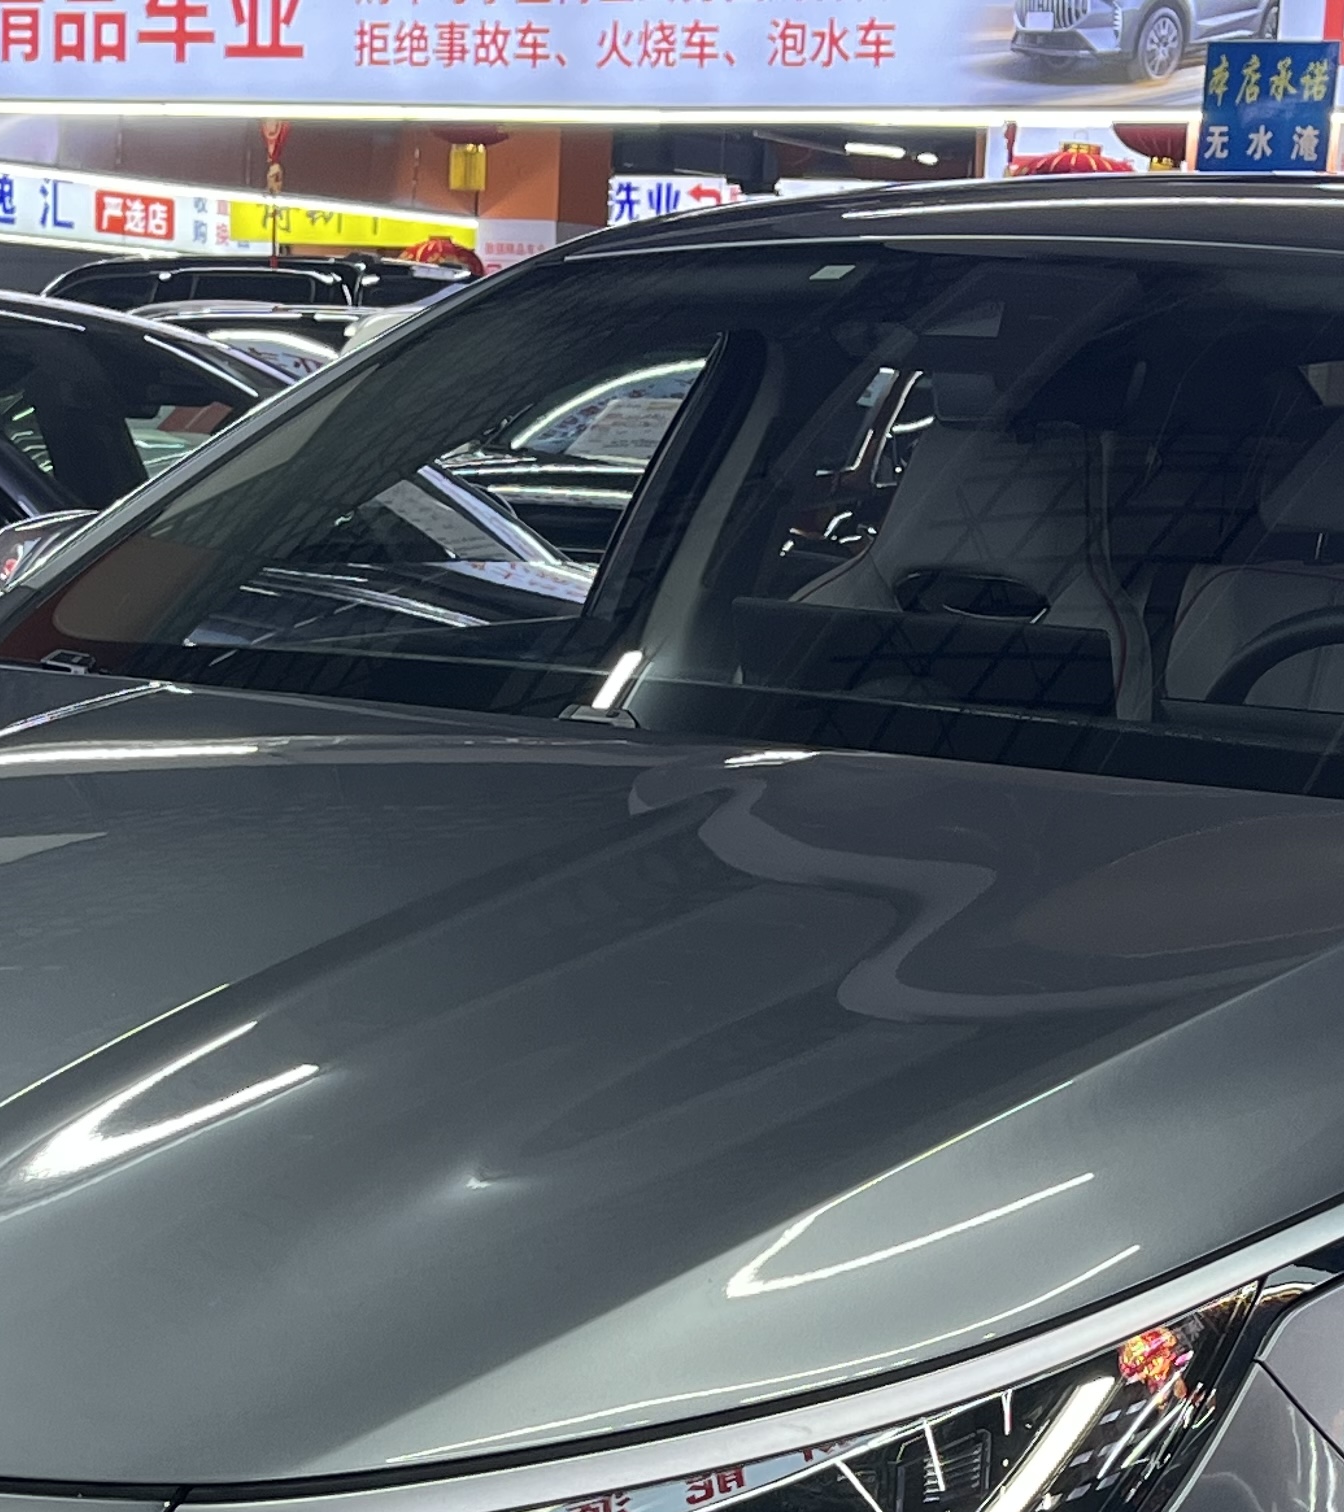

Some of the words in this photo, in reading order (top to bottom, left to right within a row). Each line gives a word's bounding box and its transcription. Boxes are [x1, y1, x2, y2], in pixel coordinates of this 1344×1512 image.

[1204, 124, 1320, 161] 无水淹
[102, 196, 168, 236] 严选店
